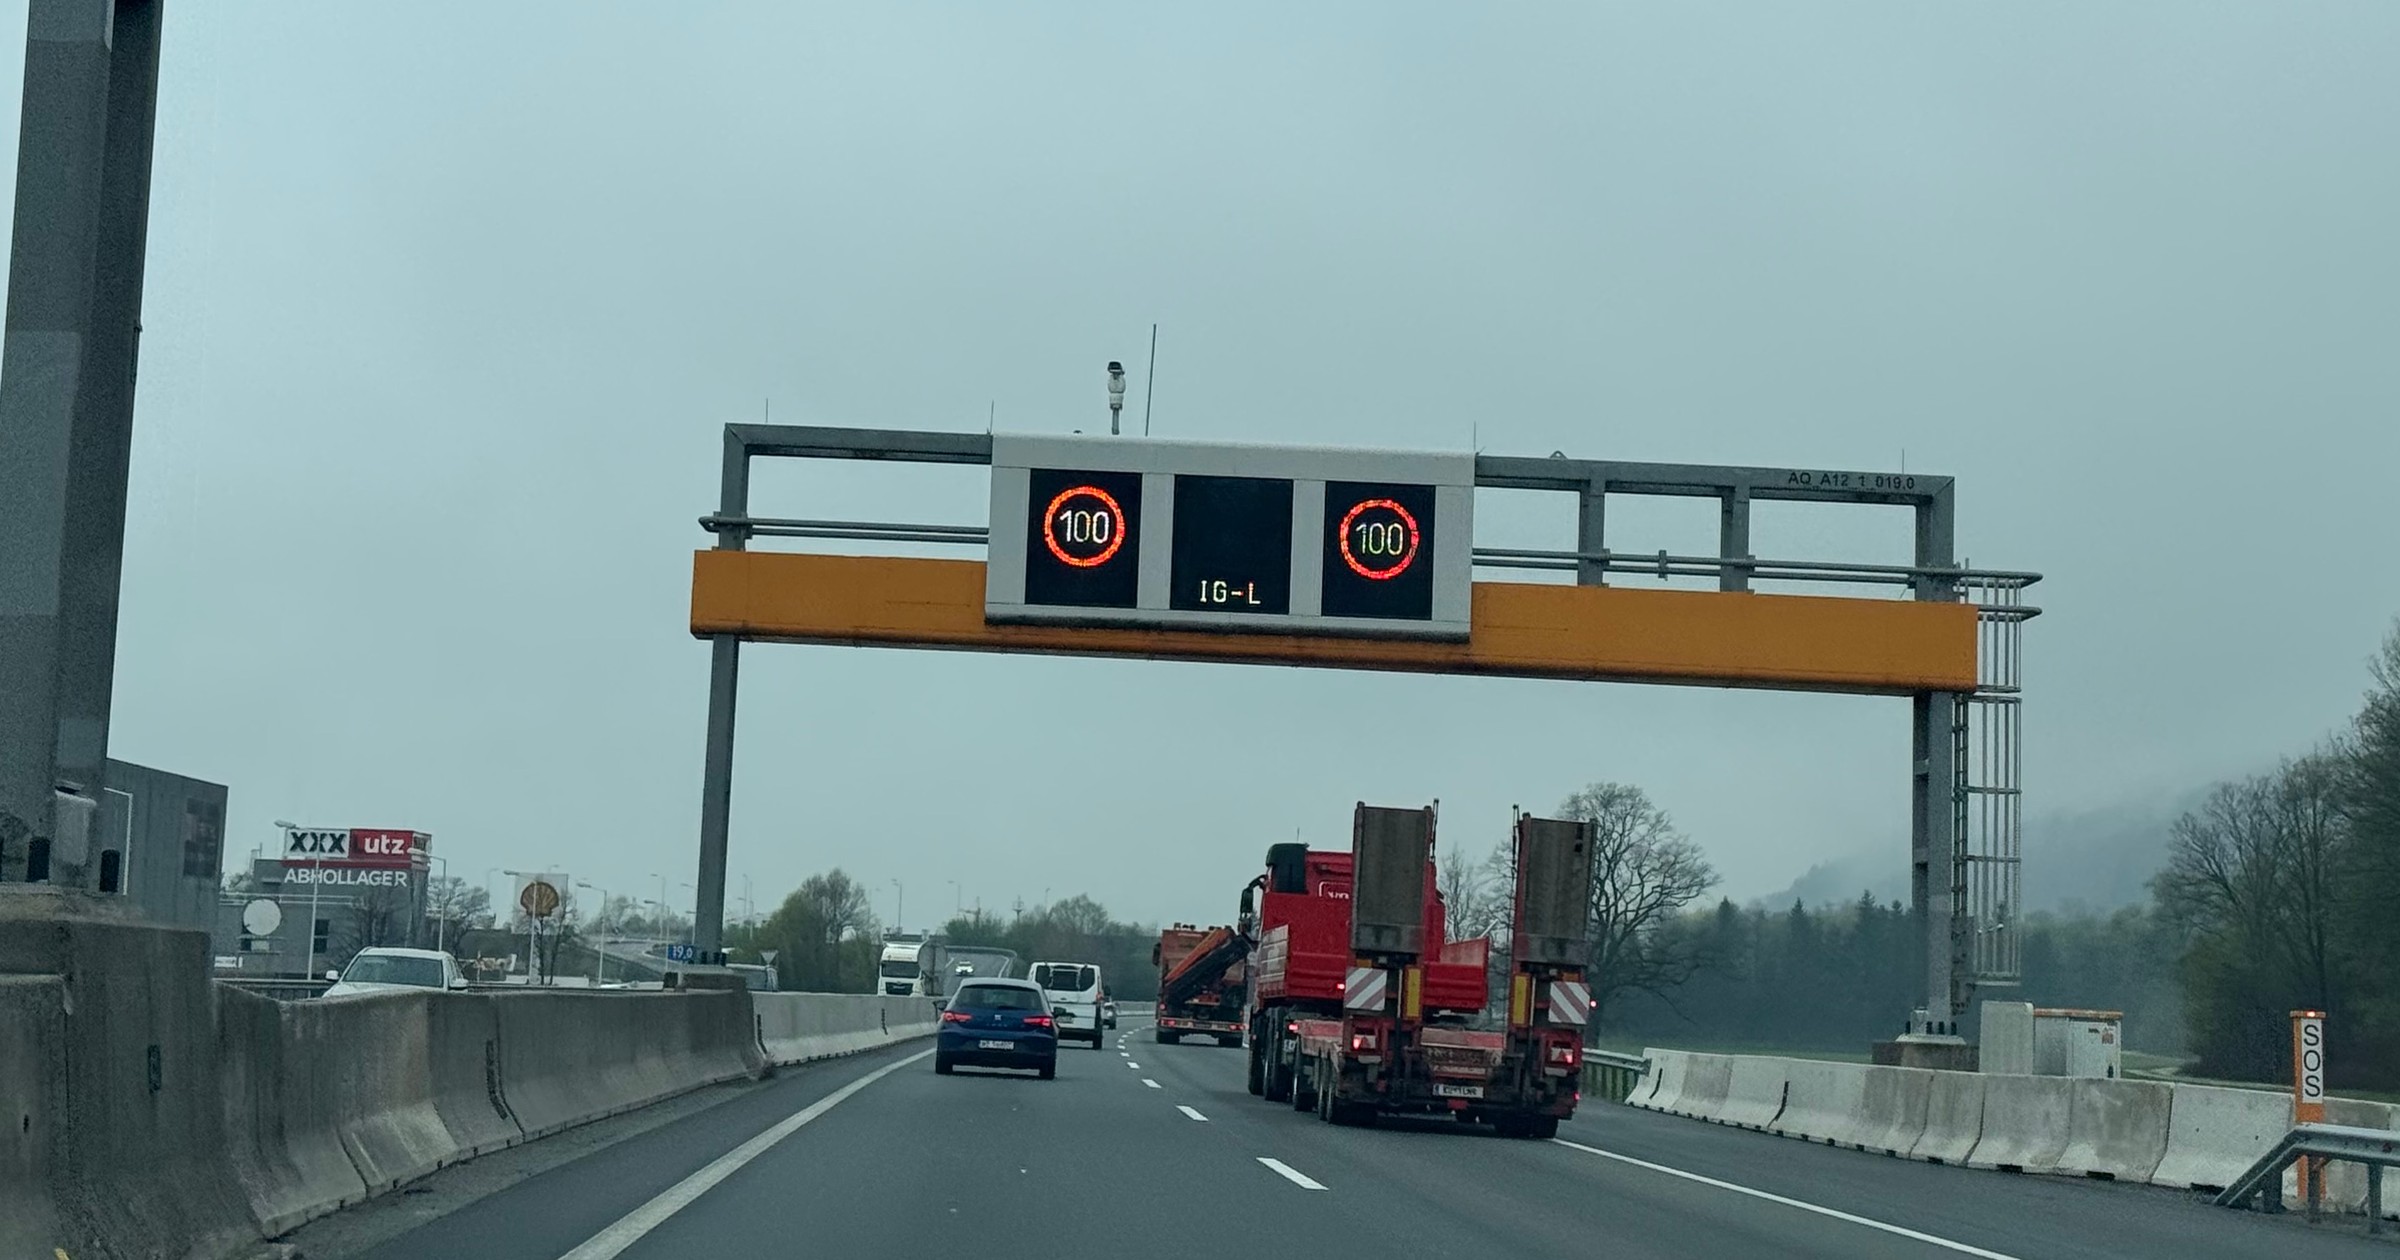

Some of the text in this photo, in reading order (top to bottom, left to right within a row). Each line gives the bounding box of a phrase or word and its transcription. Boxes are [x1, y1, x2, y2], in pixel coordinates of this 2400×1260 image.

[1059, 510, 1110, 544] 100
[1356, 522, 1403, 555] 100
[1200, 580, 1261, 605] IG-L
[290, 831, 347, 853] XXX
[284, 868, 407, 887] ABHOLLAGER
[2304, 1024, 2320, 1097] SOS
